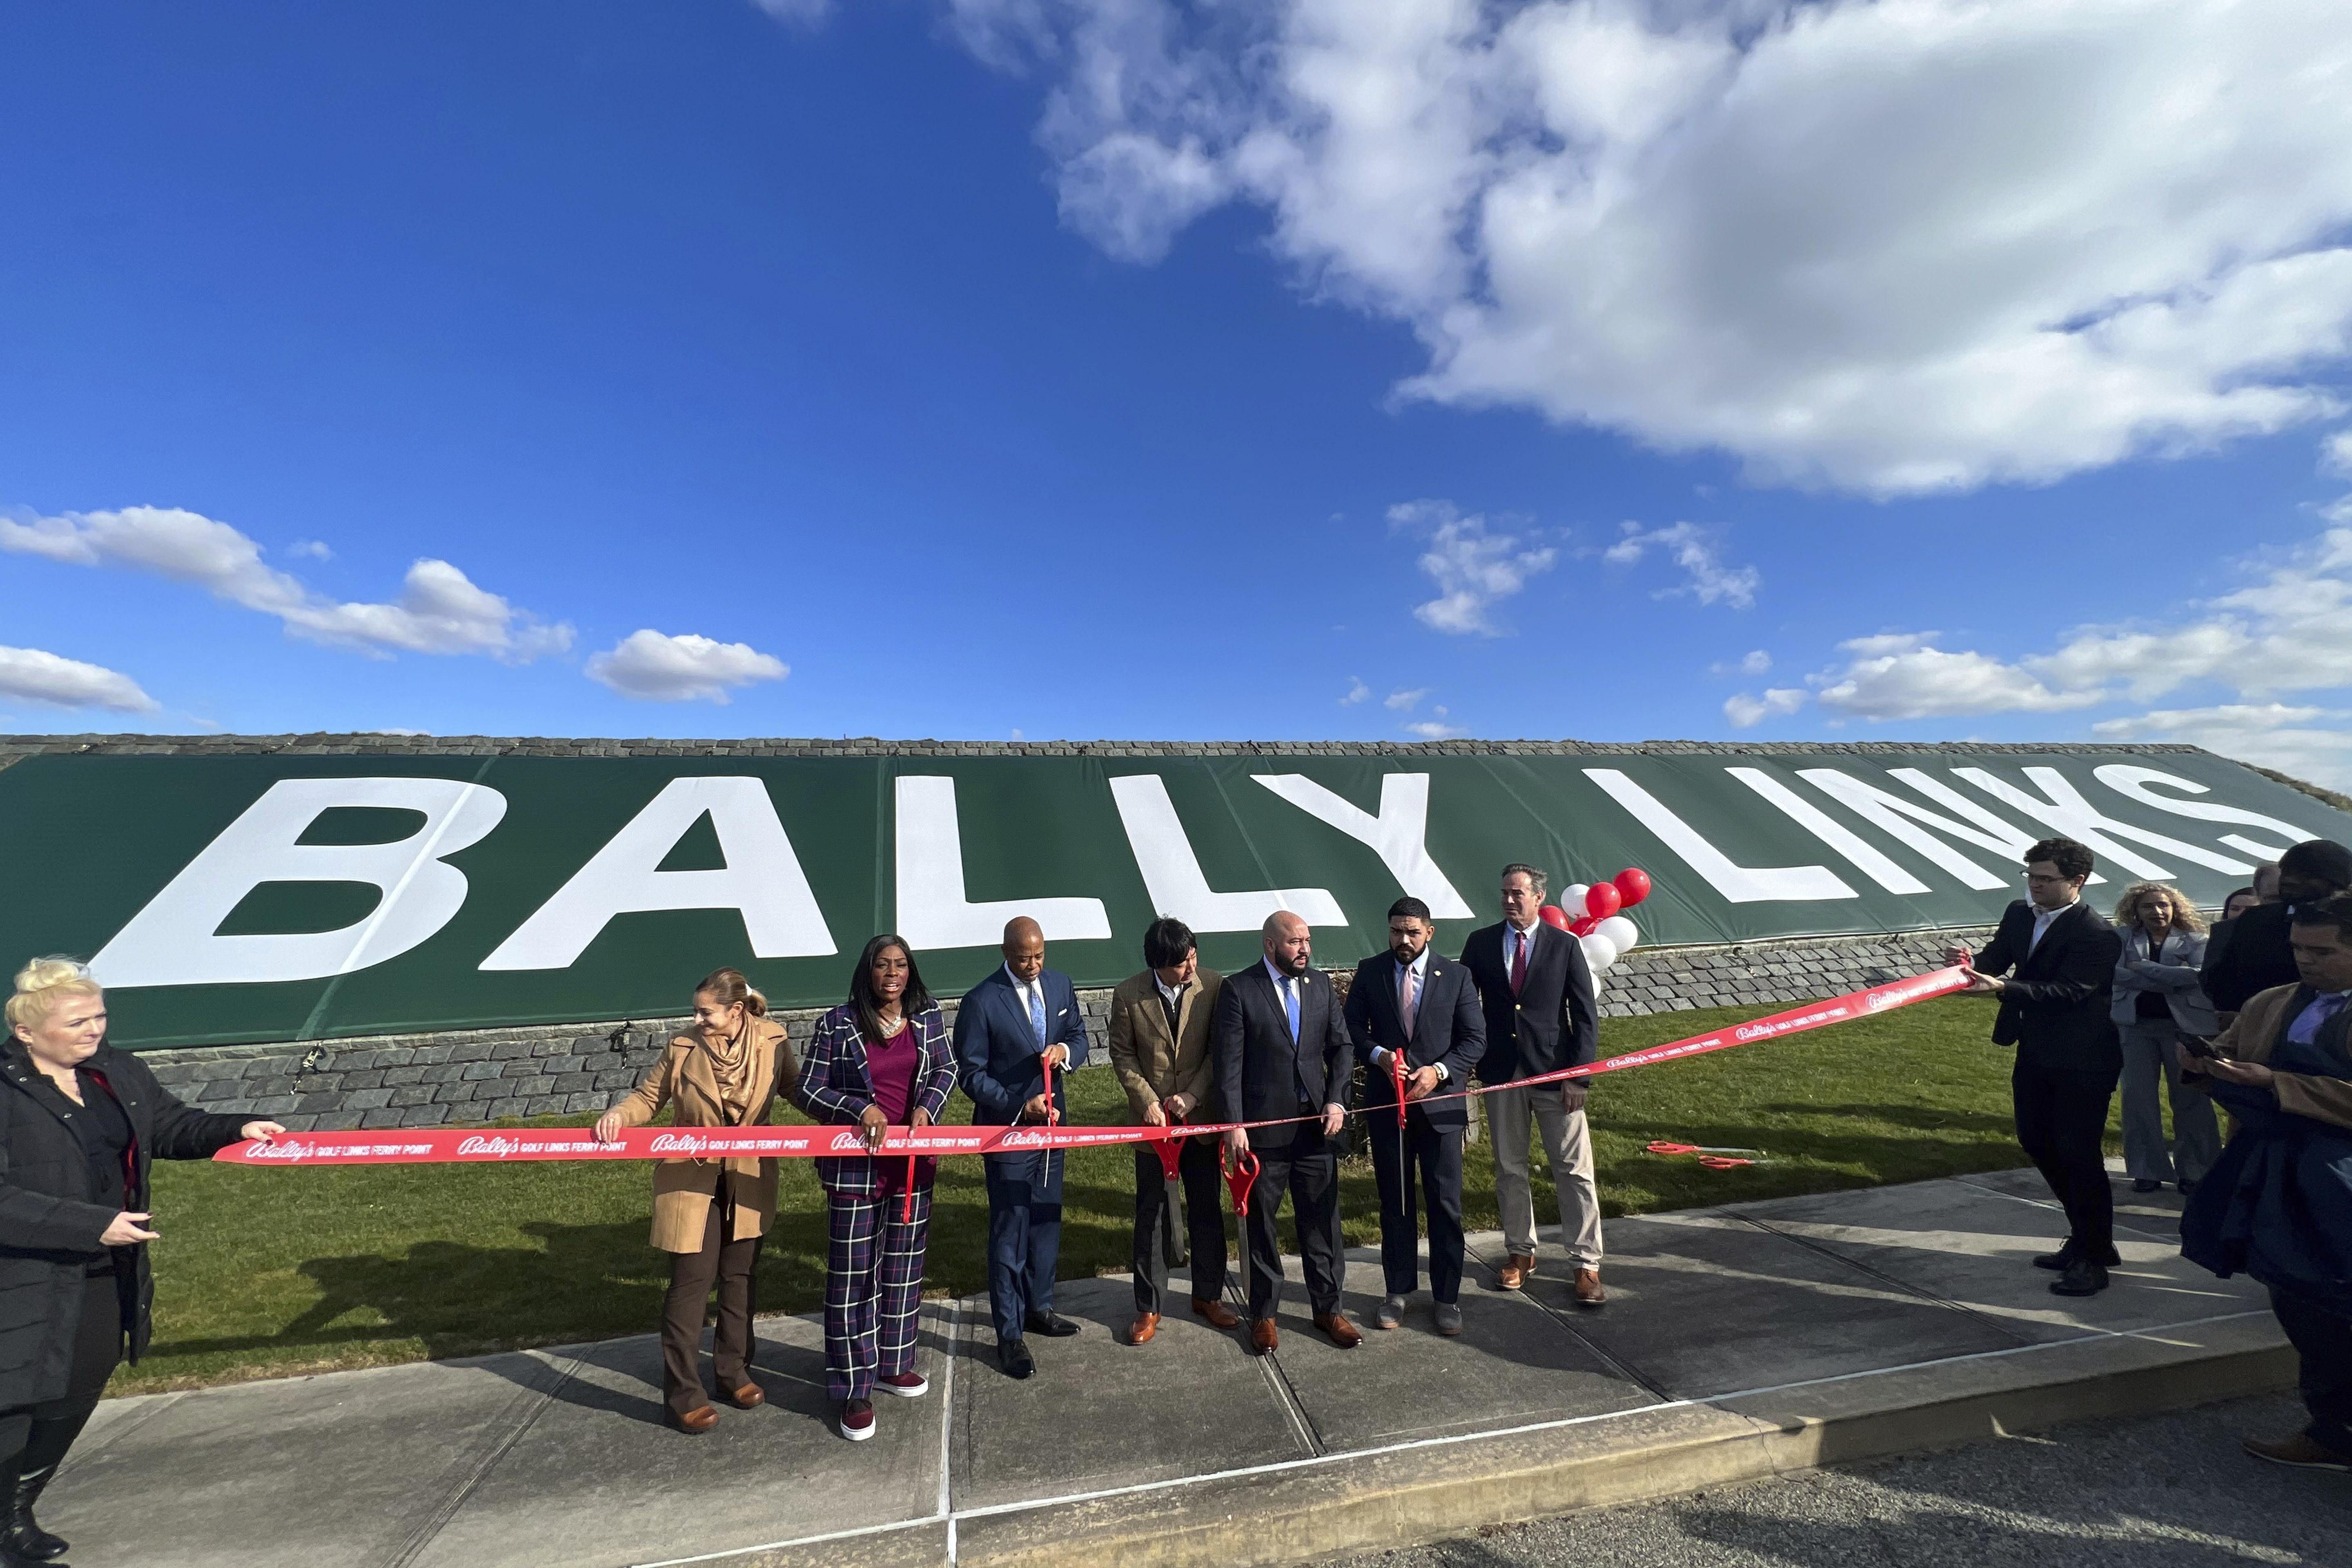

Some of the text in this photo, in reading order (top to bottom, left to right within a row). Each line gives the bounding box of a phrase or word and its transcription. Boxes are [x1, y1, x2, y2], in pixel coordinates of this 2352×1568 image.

[88, 764, 2323, 988] BALLY LINKS
[1735, 1022, 1776, 1040] Bally's
[1606, 1054, 1648, 1068] Bally's
[457, 1136, 628, 1158] Bally's GOLF LINKS FERRY POINT
[650, 1133, 809, 1155] Bally's GOLF LINKS FERRY POINT
[885, 1138, 906, 1148] GOLF
[906, 1138, 930, 1148] LINKS
[931, 1138, 956, 1148] FERRY
[958, 1137, 981, 1147] POINT
[1001, 1131, 1052, 1147] Bally's
[246, 1140, 434, 1162] Bally's GOLF LINKS FERRY POINT
